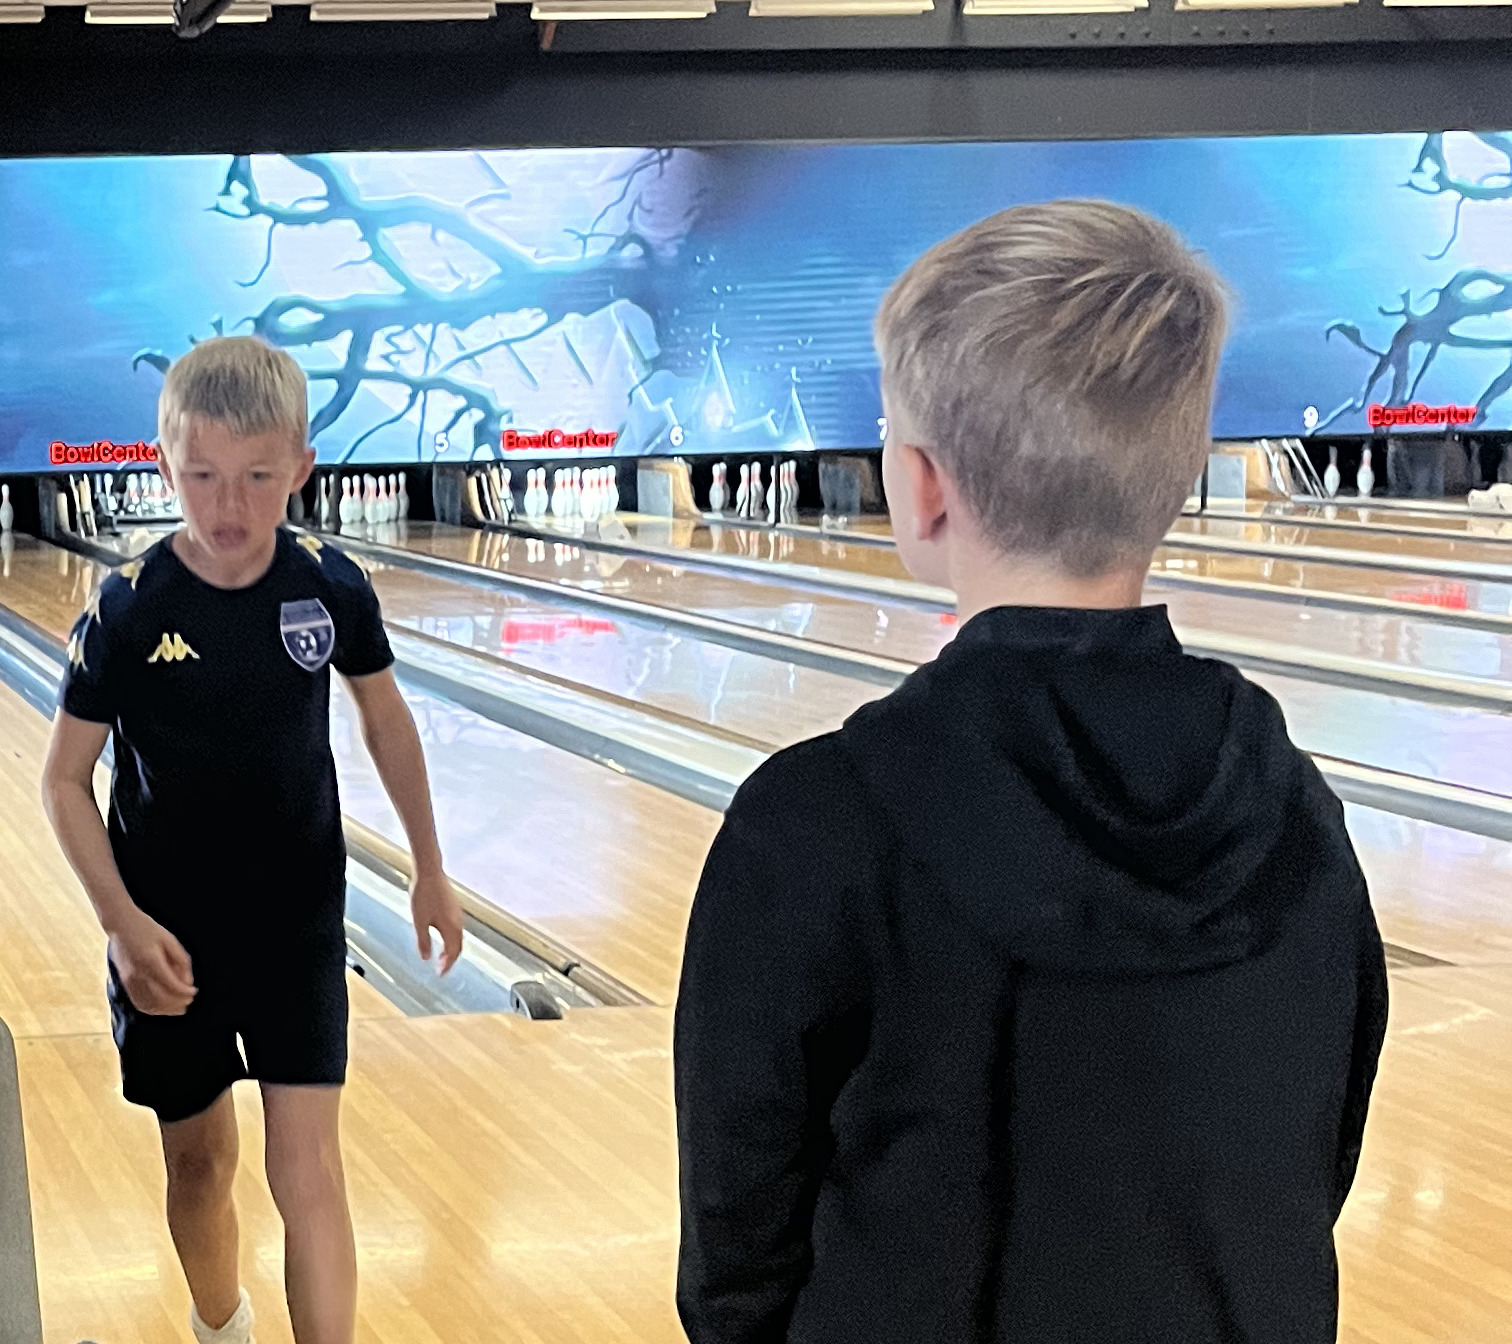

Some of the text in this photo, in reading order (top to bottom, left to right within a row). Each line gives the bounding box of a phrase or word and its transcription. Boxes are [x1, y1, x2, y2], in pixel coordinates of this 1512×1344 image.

[434, 431, 449, 453] 5
[669, 425, 684, 446] 6
[50, 441, 158, 465] BowlCente
